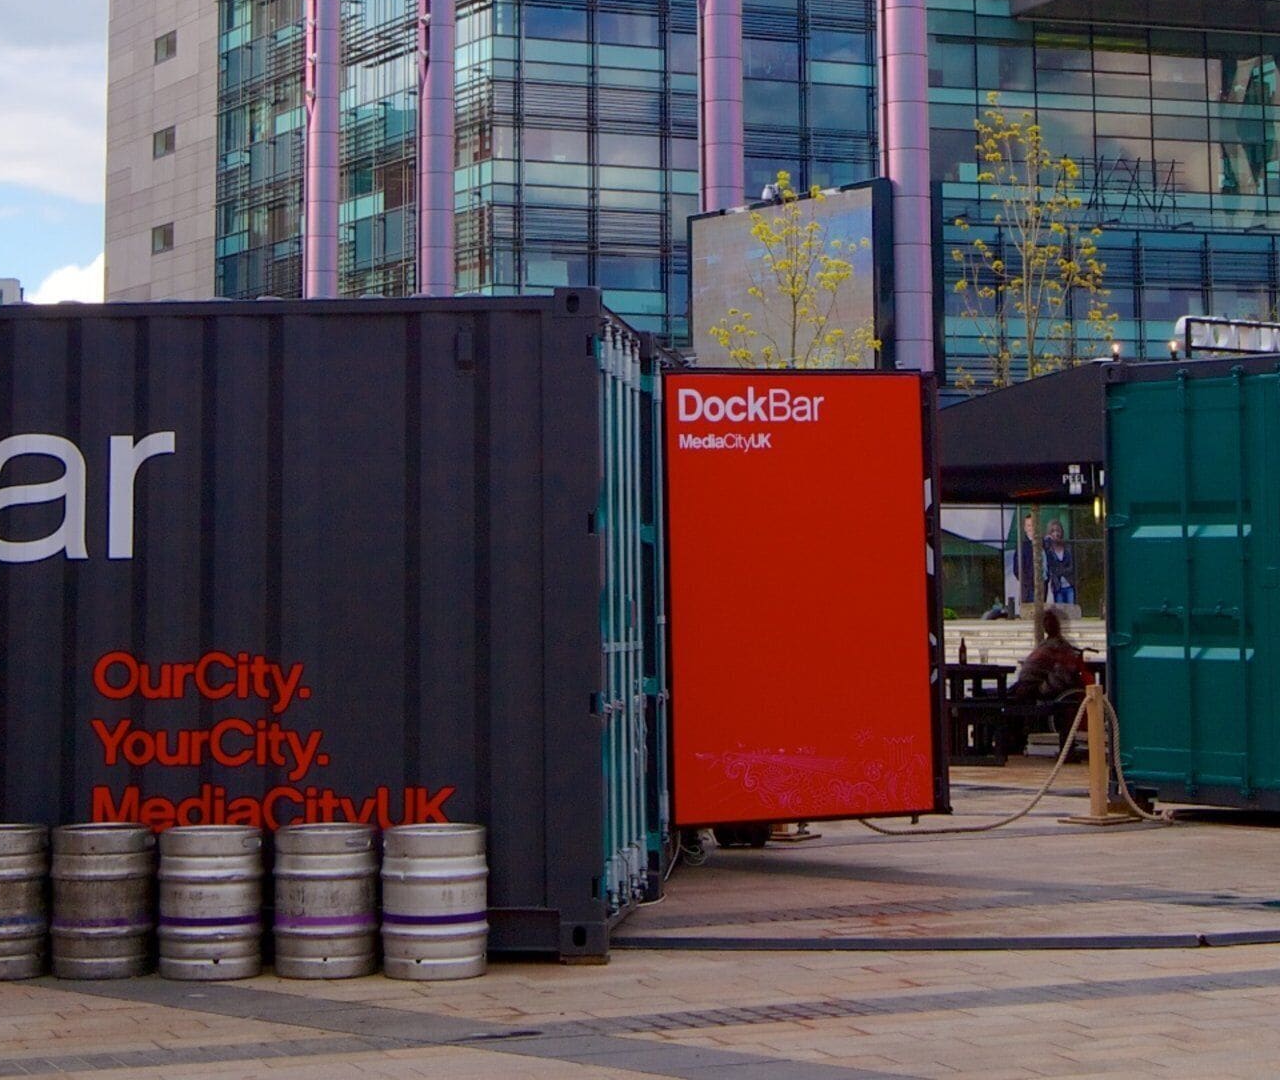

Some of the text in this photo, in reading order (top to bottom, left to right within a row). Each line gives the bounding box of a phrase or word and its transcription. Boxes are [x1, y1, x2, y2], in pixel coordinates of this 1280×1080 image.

[677, 386, 825, 422] DockBar
[678, 432, 772, 453] MediaCityUK
[92, 650, 312, 713] OurCity.
[90, 717, 330, 782] YourCity.
